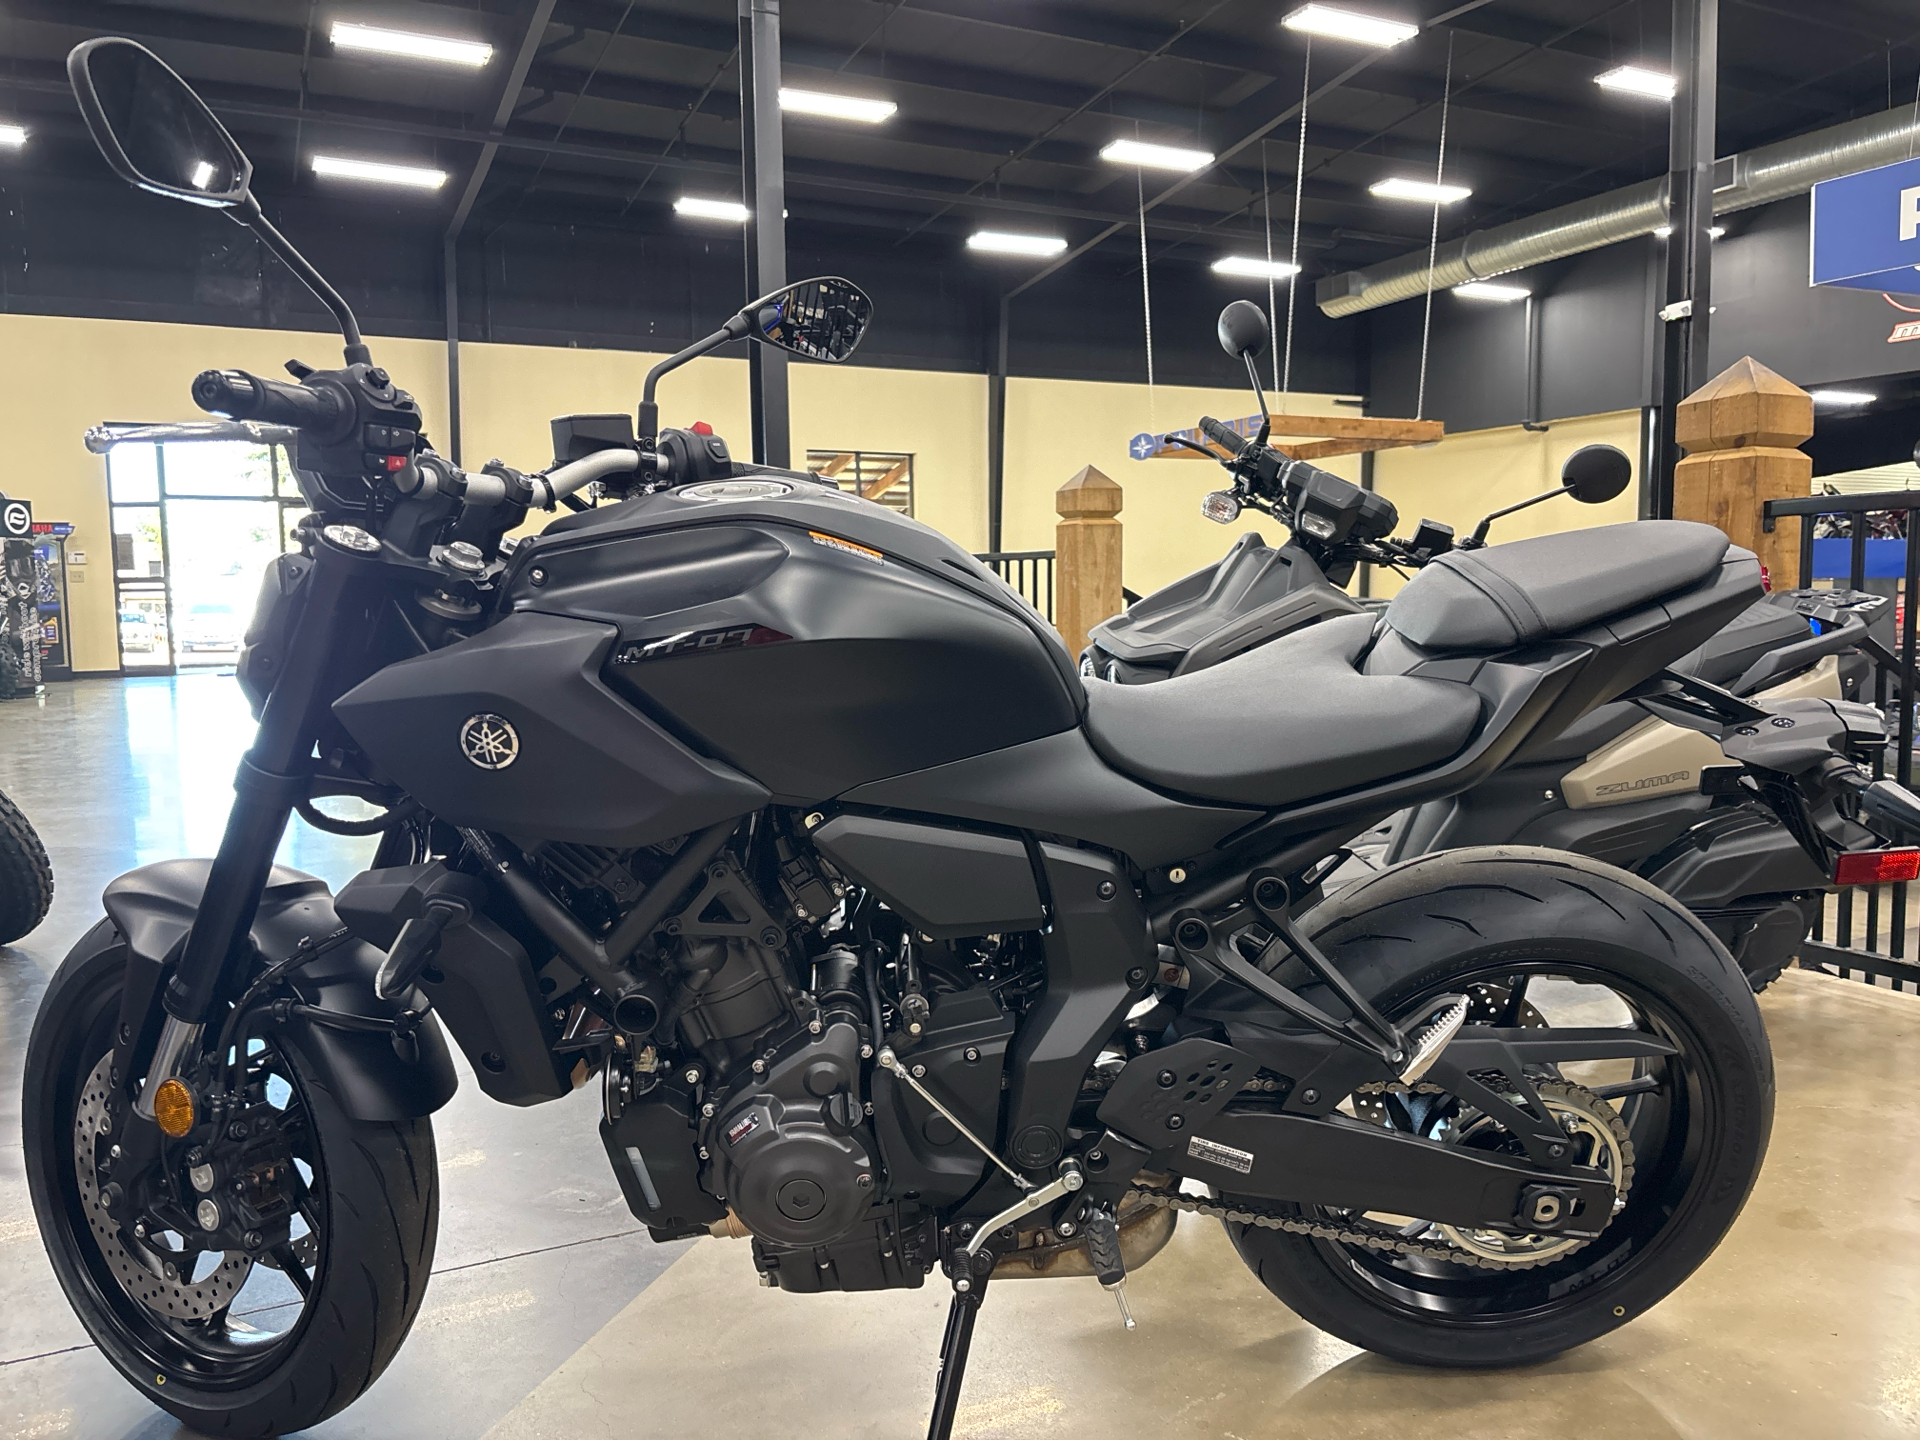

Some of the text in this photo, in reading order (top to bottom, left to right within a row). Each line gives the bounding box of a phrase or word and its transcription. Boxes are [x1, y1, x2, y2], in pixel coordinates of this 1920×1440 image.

[1154, 414, 1264, 453] POLRIS
[627, 628, 754, 660] MT-07
[1596, 770, 1690, 796] ZUMA
